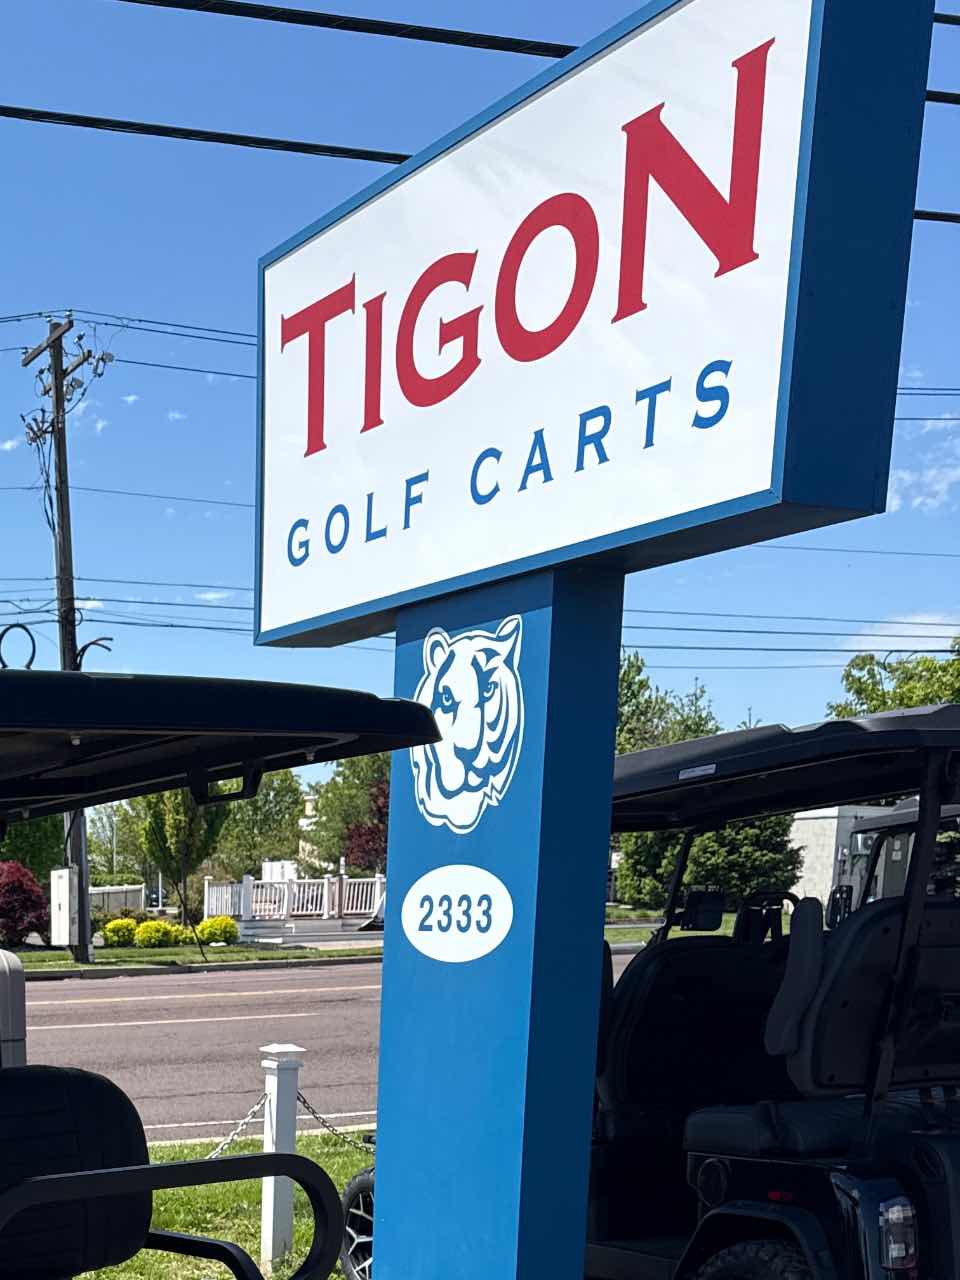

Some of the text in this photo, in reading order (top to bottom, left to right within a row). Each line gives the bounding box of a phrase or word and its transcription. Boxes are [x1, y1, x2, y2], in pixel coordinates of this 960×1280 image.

[281, 37, 775, 458] TIGON
[287, 360, 733, 567] GOLF CARTS
[418, 894, 492, 933] 2333
